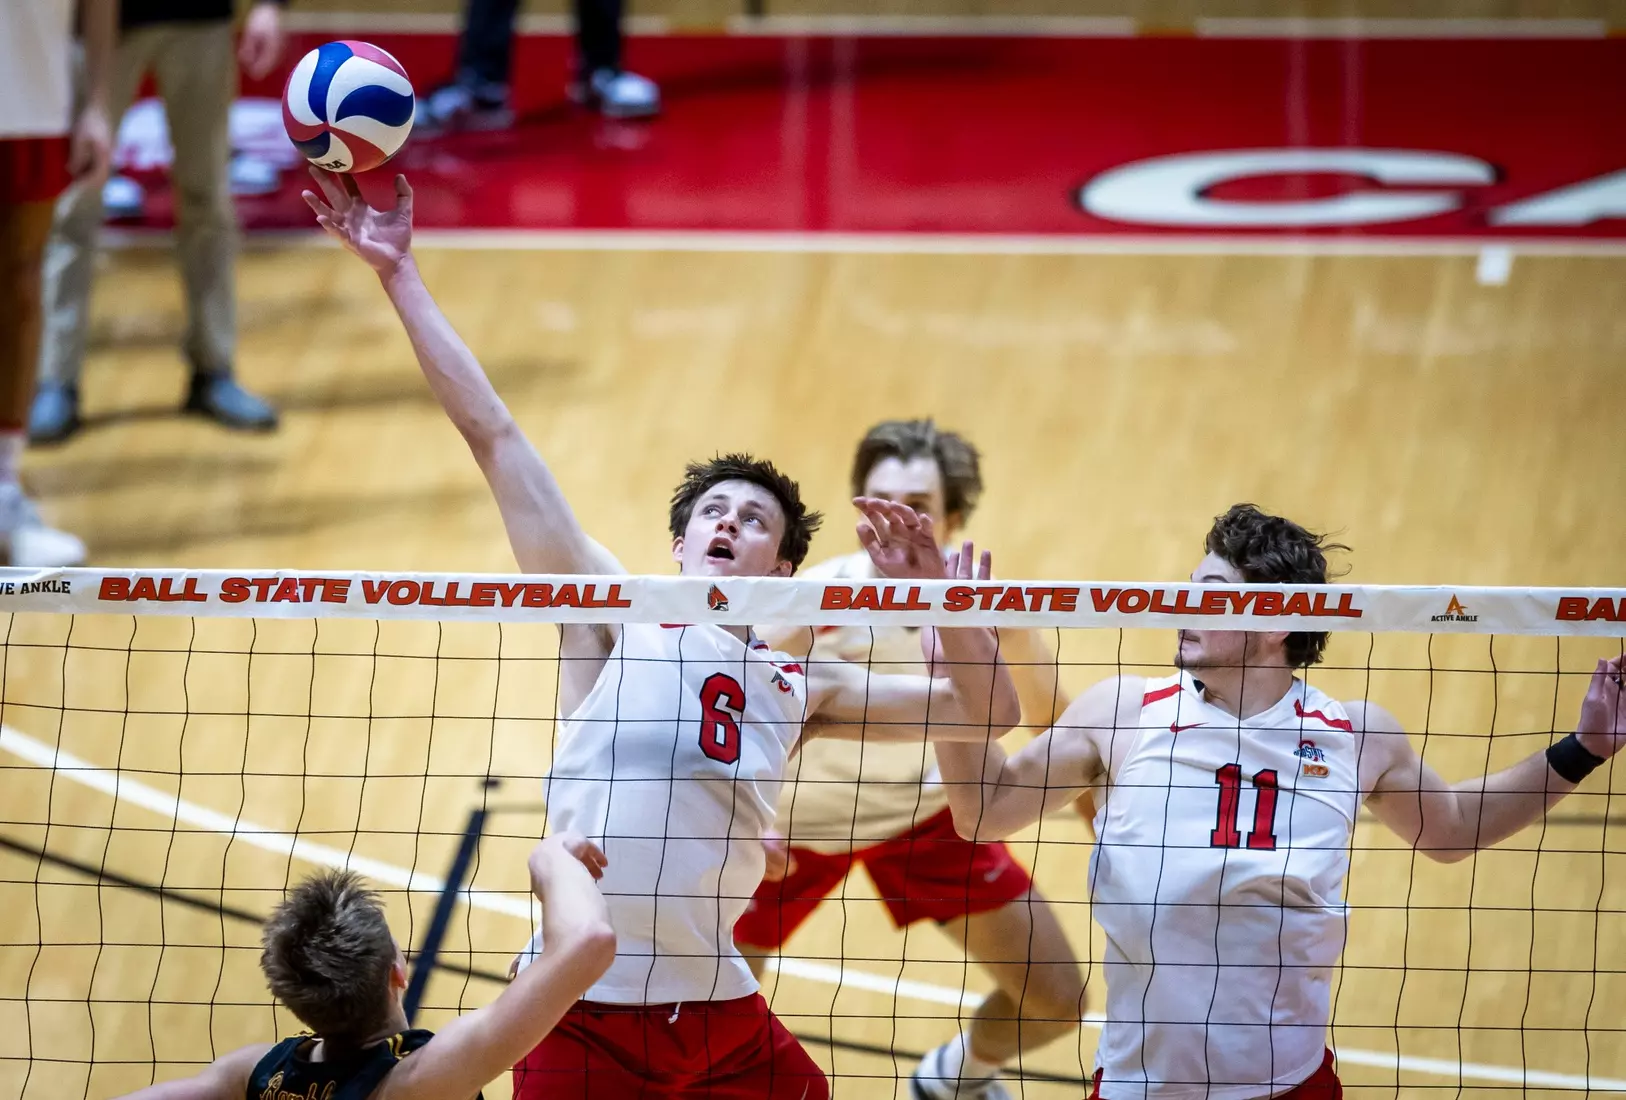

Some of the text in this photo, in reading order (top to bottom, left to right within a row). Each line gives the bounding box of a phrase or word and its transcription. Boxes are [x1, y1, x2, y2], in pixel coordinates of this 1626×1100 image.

[20, 580, 71, 594] ANKLE
[98, 577, 632, 608] BALL STATE VOLLEYBALL
[820, 585, 1362, 618] BALL STATE VOLLEYBALL
[1431, 614, 1478, 622] ACTIVE ANKLE
[1555, 597, 1626, 622] BA
[698, 672, 746, 765] 6
[1210, 763, 1279, 851] 11
